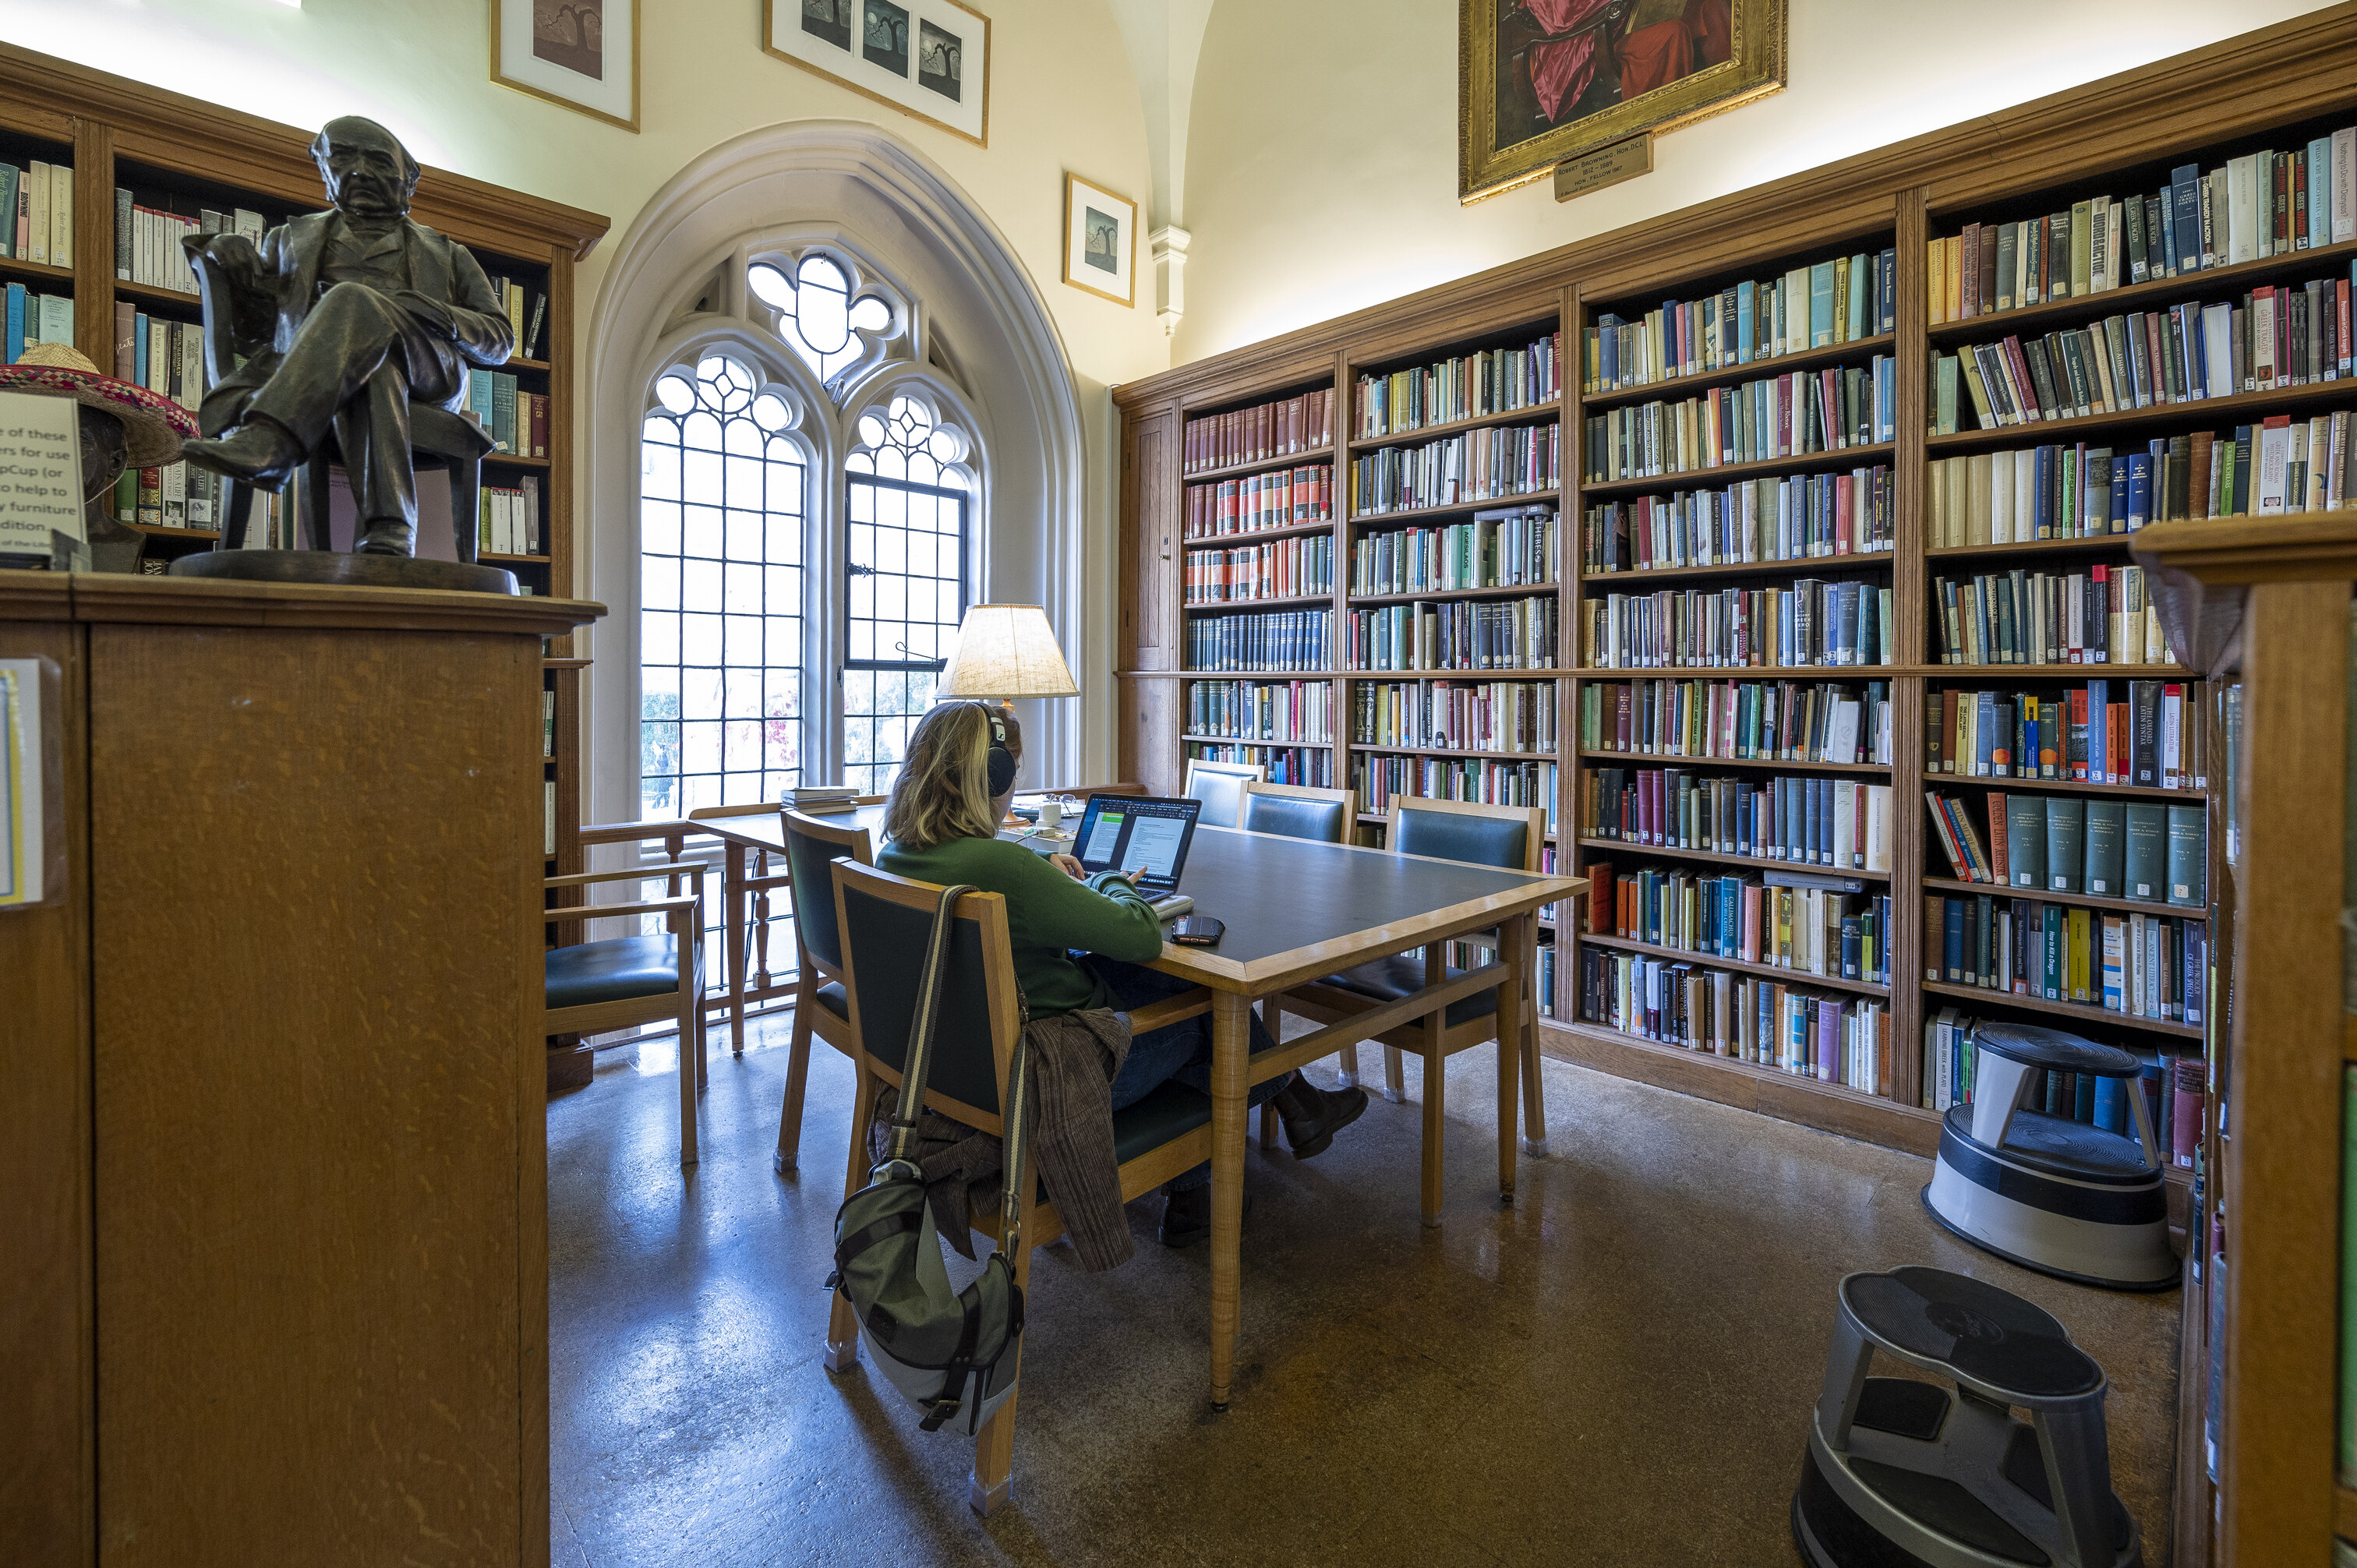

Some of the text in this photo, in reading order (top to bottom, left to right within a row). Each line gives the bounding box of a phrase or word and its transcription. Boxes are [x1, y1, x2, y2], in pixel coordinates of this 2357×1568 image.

[2338, 142, 2348, 163] Nothing
[1558, 164, 1578, 175] ROBERT
[1582, 167, 1594, 175] 1812
[1600, 160, 1613, 170] 1889
[1589, 169, 1612, 181] FELLOW
[19, 192, 29, 218] BROWNING
[2296, 164, 2306, 235] READING GREEK TRAGEDY
[2338, 189, 2348, 217] Dionysos?
[58, 210, 66, 246] Robert Browning
[1971, 290, 1977, 298] IN
[2116, 353, 2126, 377] ATHENS?
[2075, 376, 2083, 390] Athenian
[8, 428, 23, 437] of
[28, 429, 68, 442] these
[21, 447, 41, 457] for
[46, 452, 70, 461] use
[43, 468, 63, 479] (or
[16, 483, 48, 497] help
[52, 488, 68, 496] to
[10, 502, 76, 516] furniture
[1952, 802, 1976, 847] LATIN METRE
[1992, 800, 2005, 876] GOLDEN LATIN ARTISTRY
